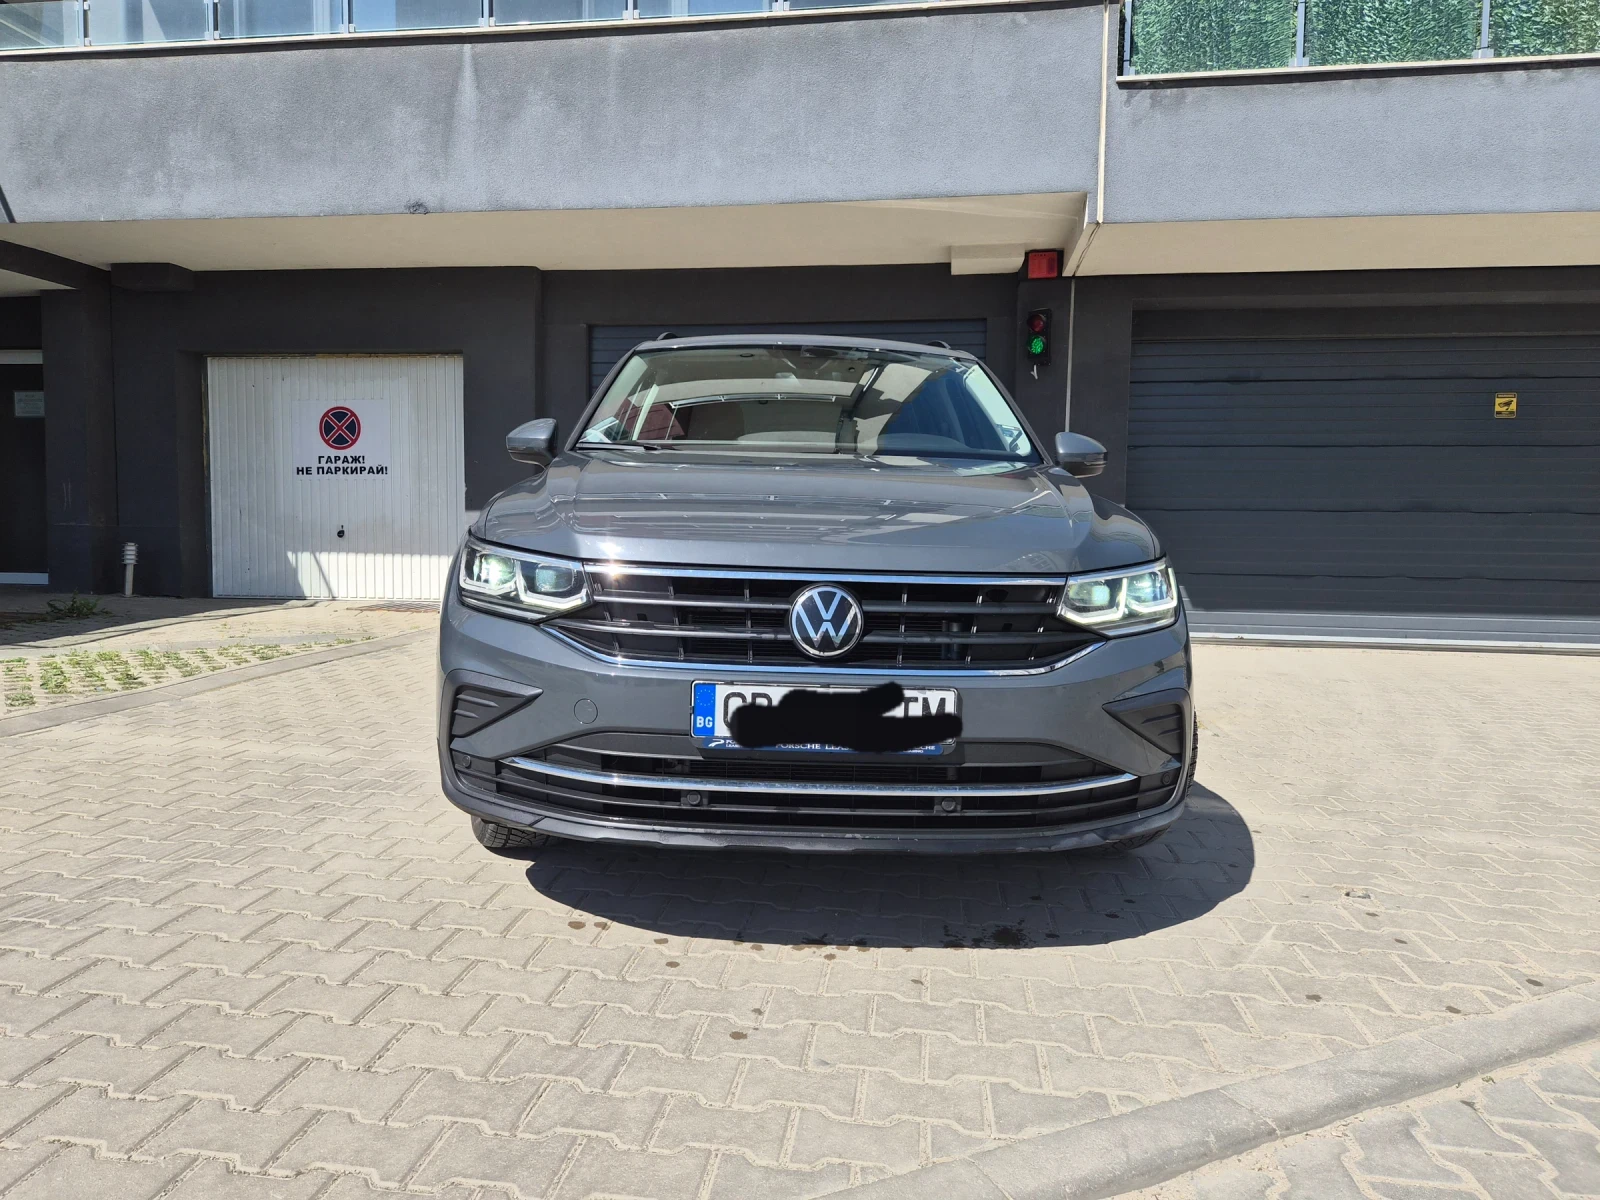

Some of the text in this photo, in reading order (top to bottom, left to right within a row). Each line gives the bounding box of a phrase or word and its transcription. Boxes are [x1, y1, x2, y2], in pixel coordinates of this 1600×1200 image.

[318, 455, 365, 465] ГАРАЖ!
[296, 464, 388, 475] НЕ ПАРКИРАЙ!
[794, 587, 859, 652] VW
[696, 715, 713, 728] BG
